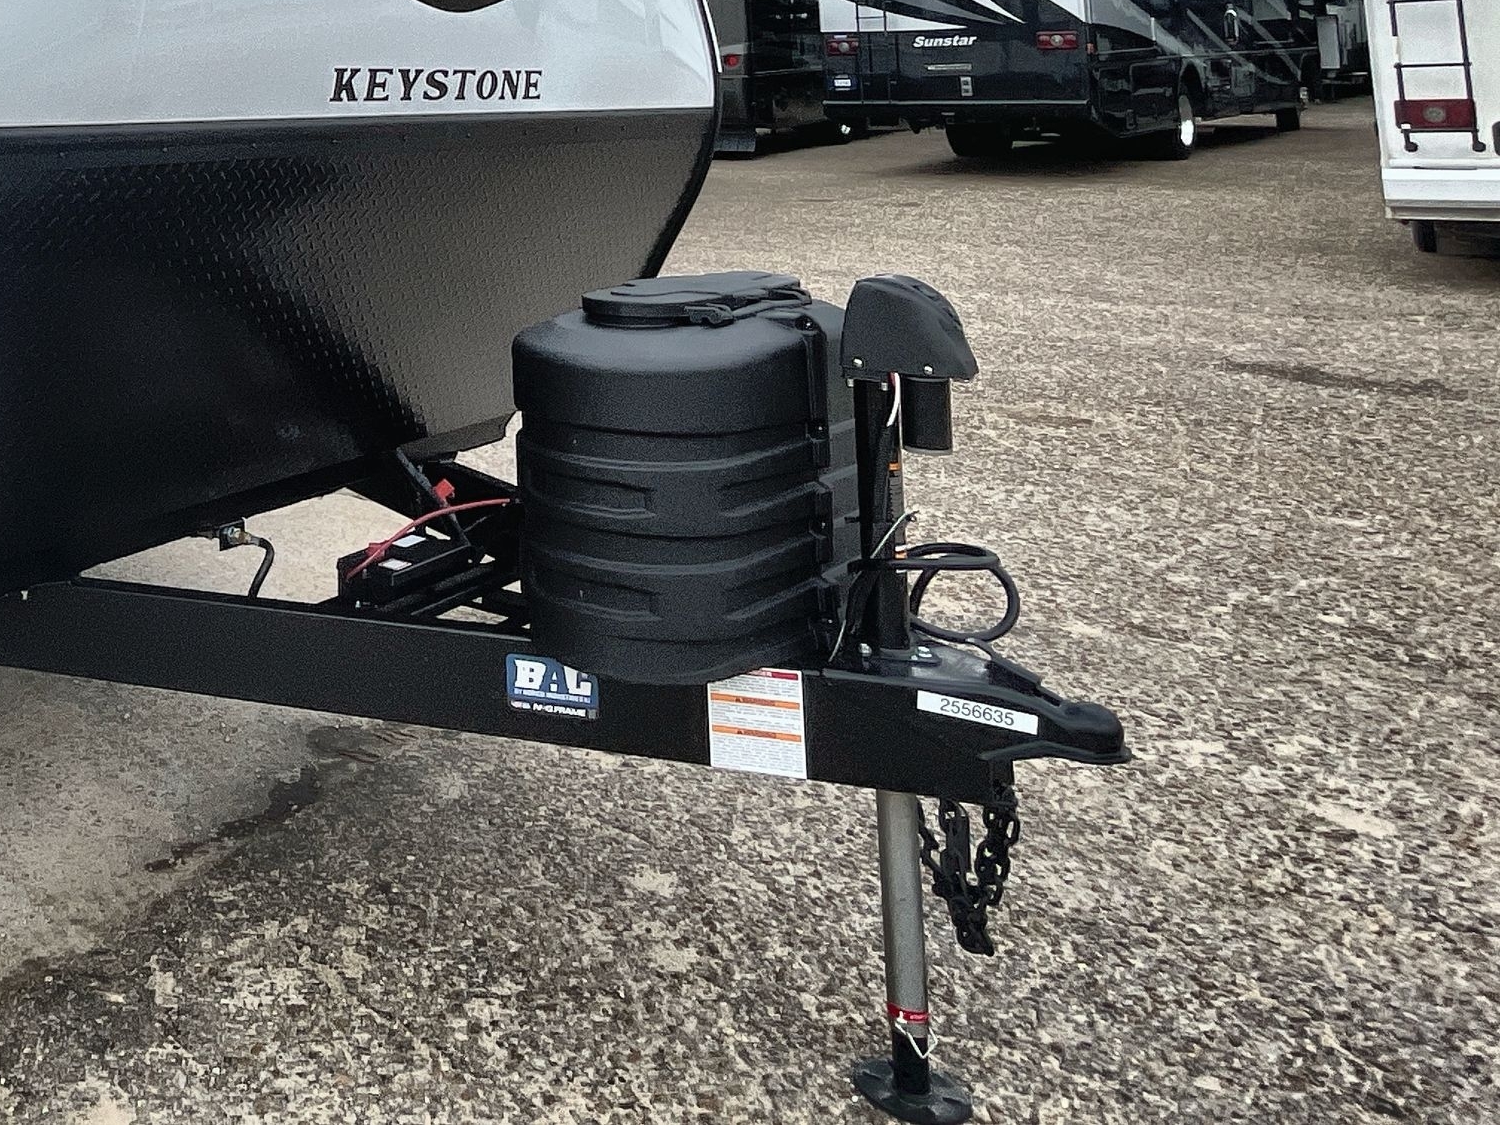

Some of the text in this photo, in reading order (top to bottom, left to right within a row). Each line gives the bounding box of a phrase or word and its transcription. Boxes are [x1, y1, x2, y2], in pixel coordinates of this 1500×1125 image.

[912, 35, 978, 48] Sunstar
[329, 67, 543, 103] KEYSTONE
[939, 697, 1015, 727] 2556635
